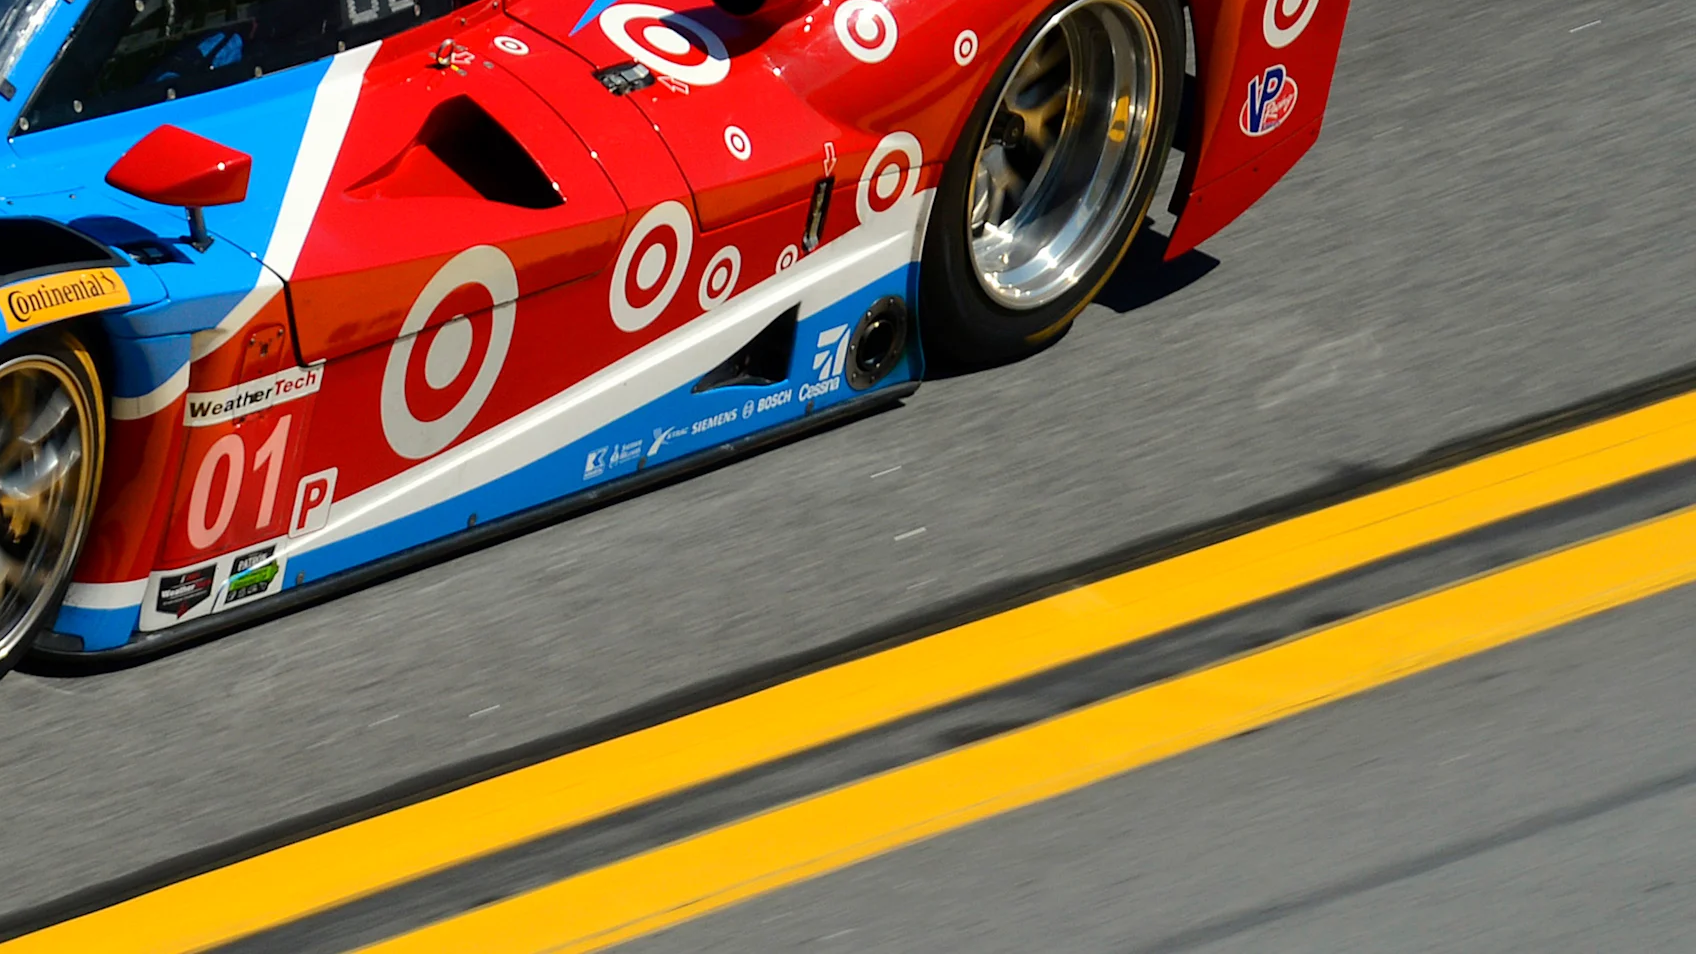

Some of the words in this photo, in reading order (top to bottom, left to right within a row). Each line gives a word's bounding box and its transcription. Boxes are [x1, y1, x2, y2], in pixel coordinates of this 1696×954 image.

[1246, 66, 1286, 134] VP
[8, 273, 106, 323] Continental
[189, 371, 317, 418] WeatherTech
[757, 388, 792, 414] BOSCH
[798, 375, 841, 403] Cessna
[691, 408, 738, 435] SIEMENS
[187, 414, 292, 549] 01
[296, 477, 328, 531] P
